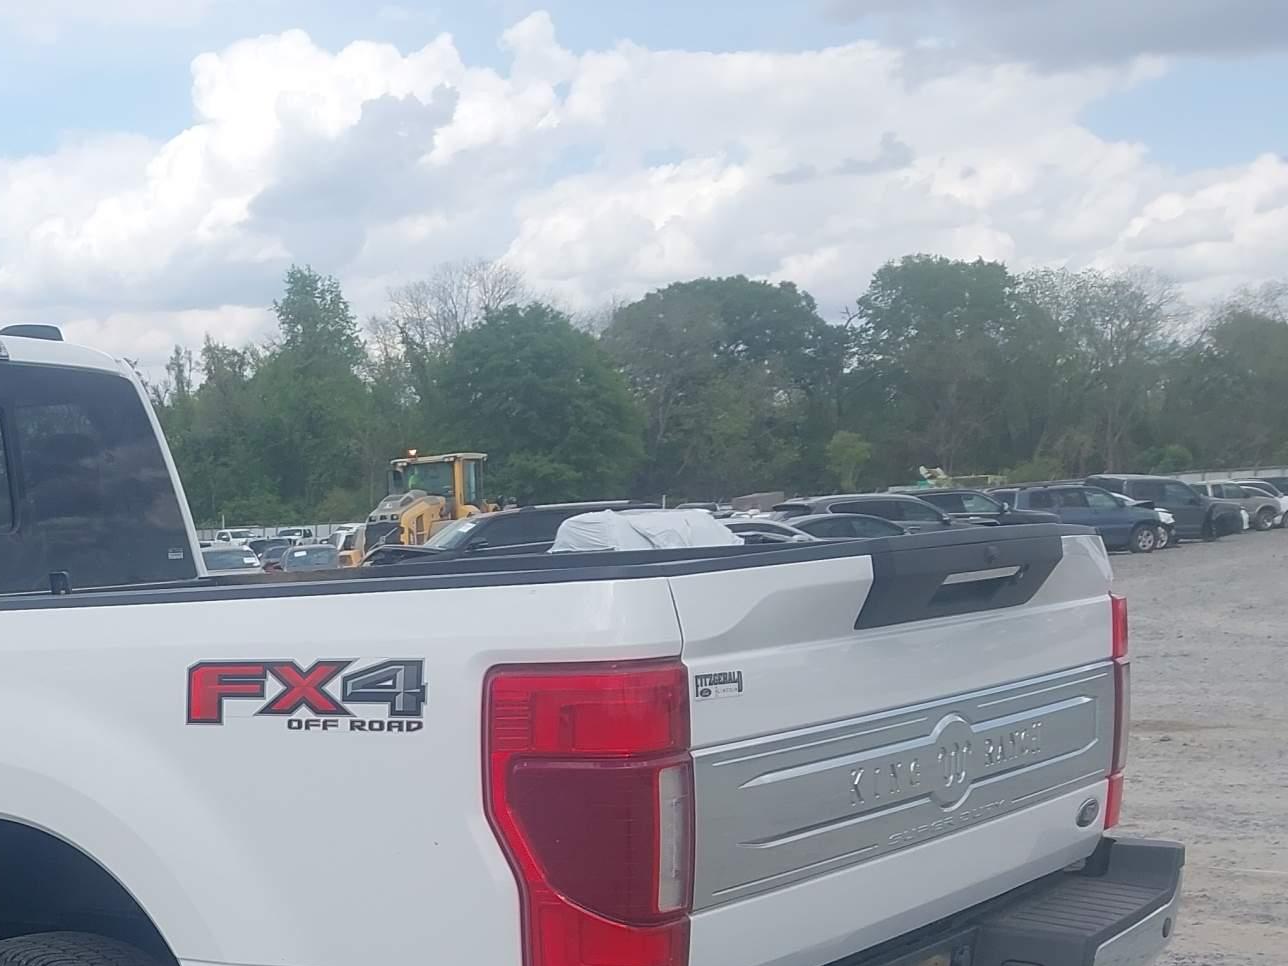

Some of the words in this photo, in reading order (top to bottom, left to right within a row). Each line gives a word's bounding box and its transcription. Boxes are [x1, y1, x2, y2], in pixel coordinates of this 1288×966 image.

[186, 658, 429, 725] FX4
[695, 670, 743, 698] FITZGERALD
[287, 719, 339, 731] OFF
[349, 719, 424, 732] ROAD
[850, 758, 921, 807] KING
[984, 721, 1043, 767] RANCH
[888, 815, 955, 846] SUPER
